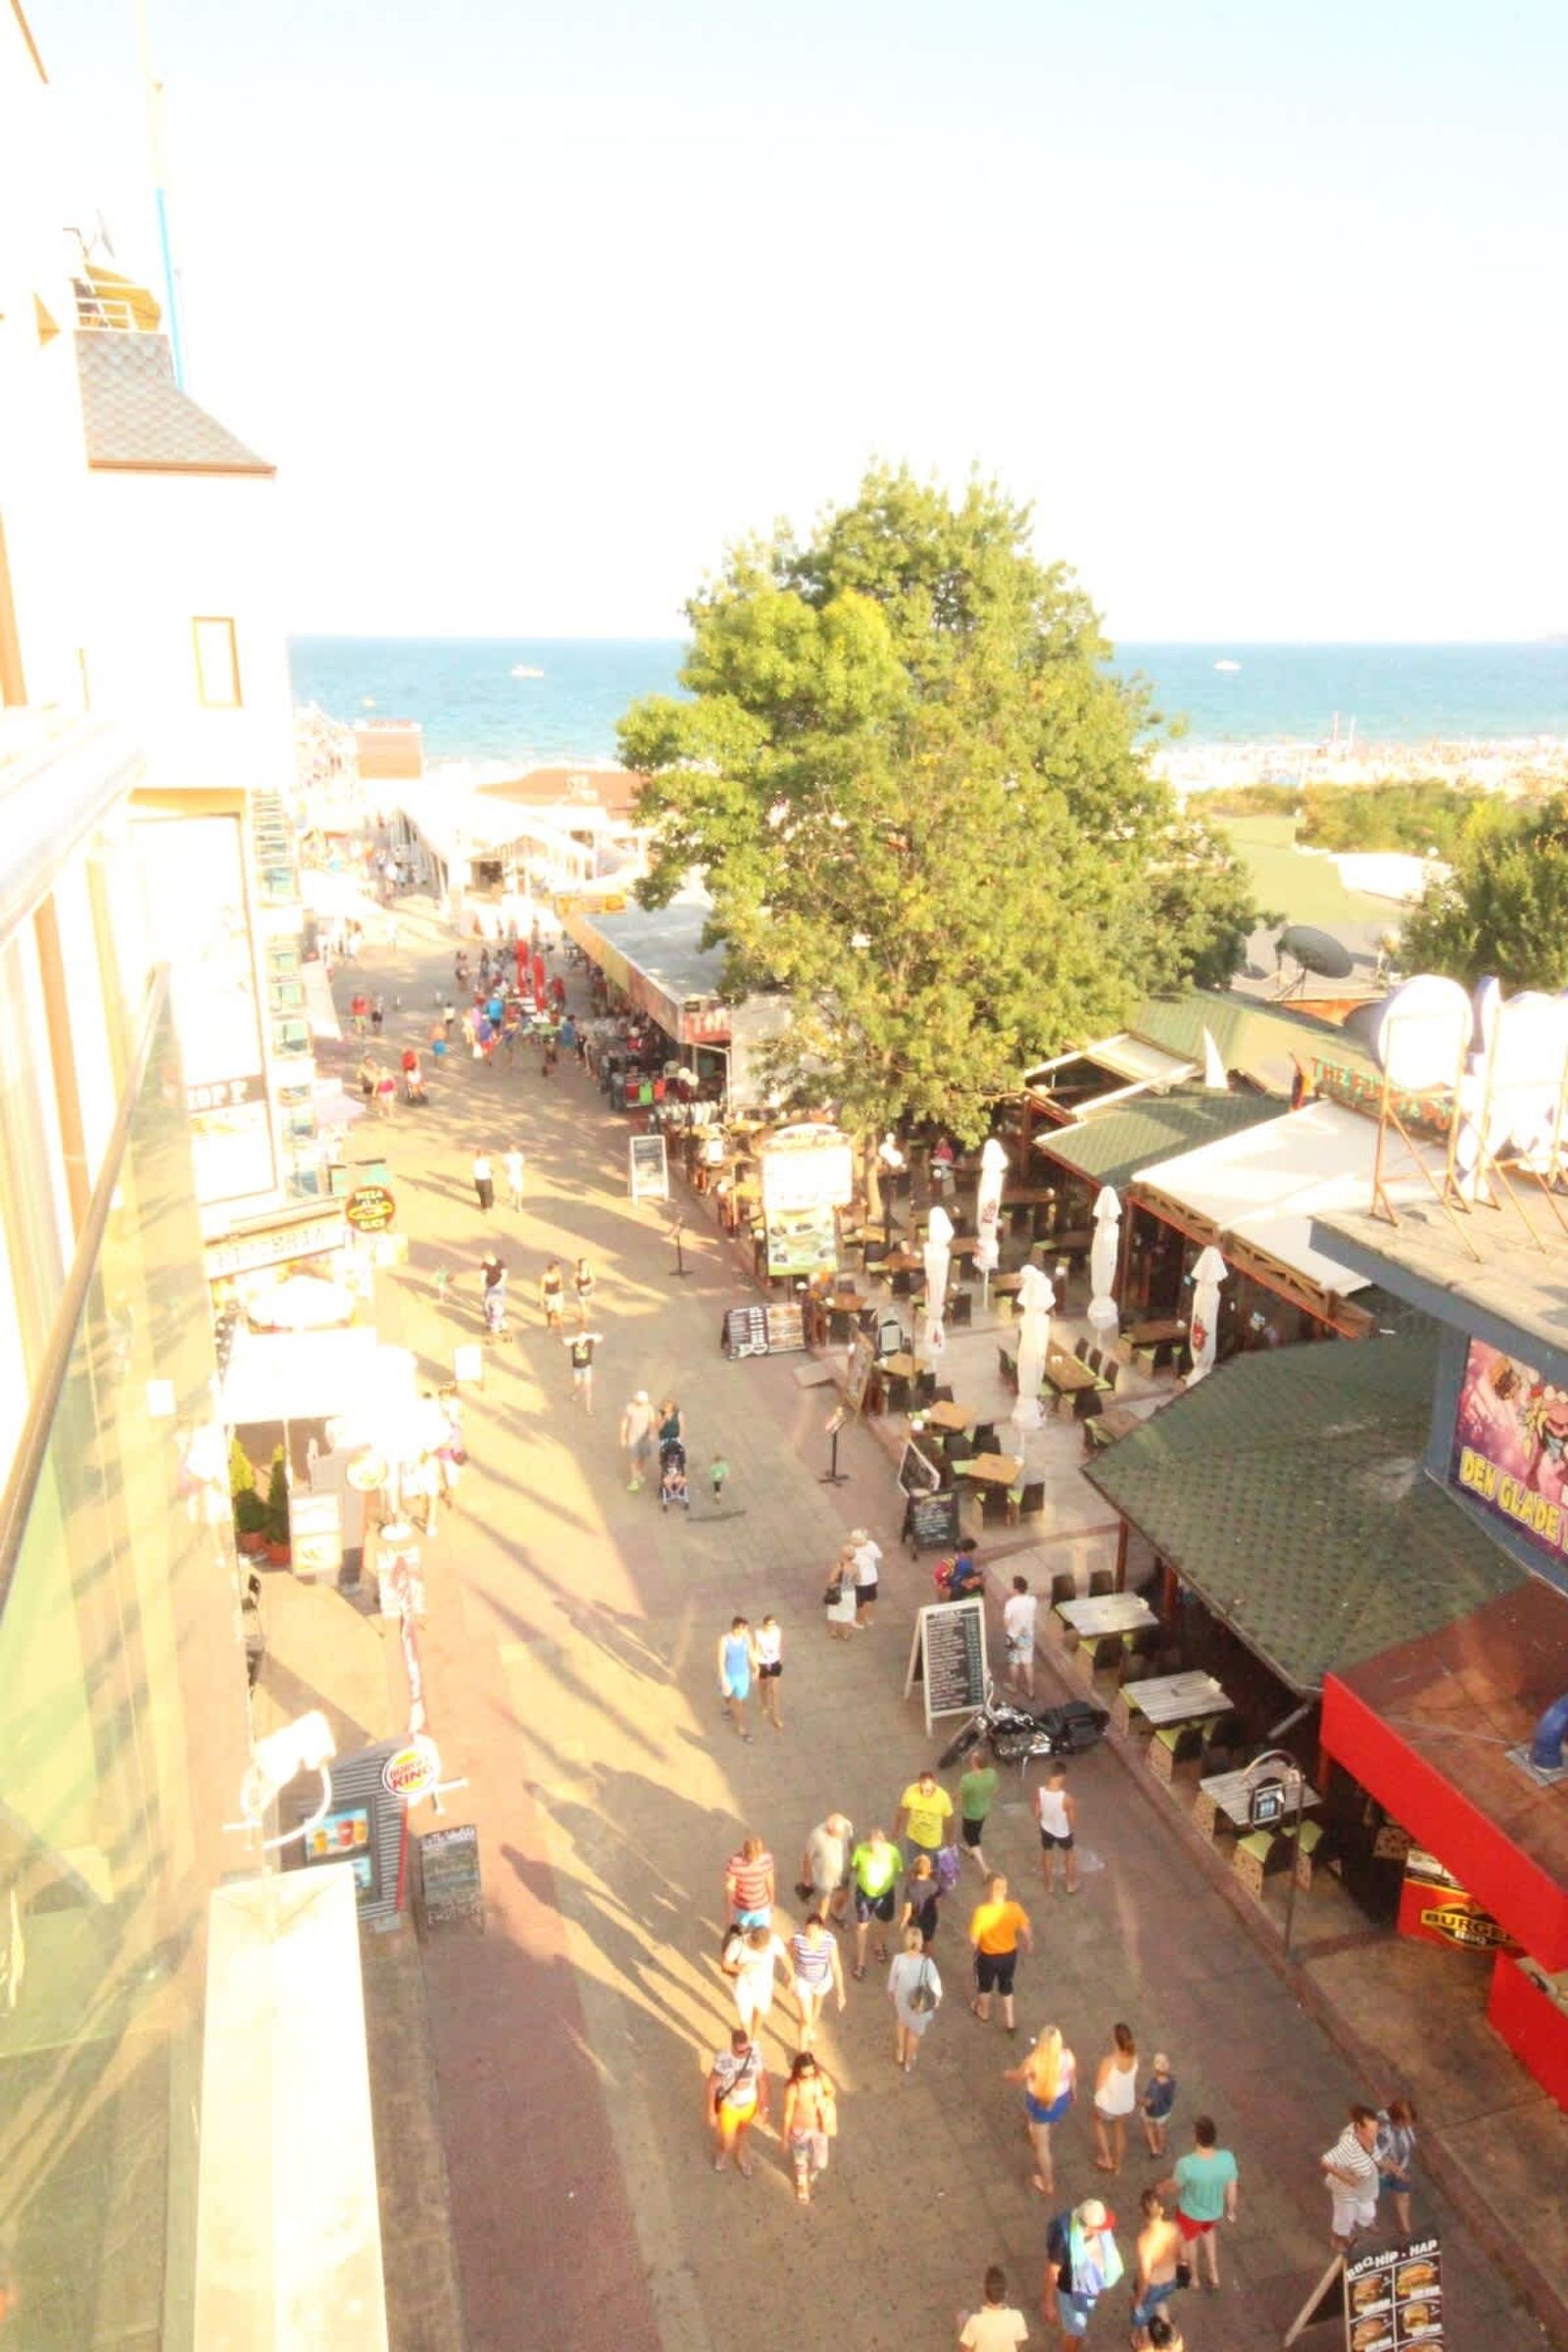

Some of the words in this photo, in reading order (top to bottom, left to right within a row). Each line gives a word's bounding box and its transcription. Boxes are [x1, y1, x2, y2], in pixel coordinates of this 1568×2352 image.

[1459, 1447, 1494, 1499] DEN
[1497, 1475, 1561, 1545] GLADE
[1409, 2239, 1438, 2256] HAP
